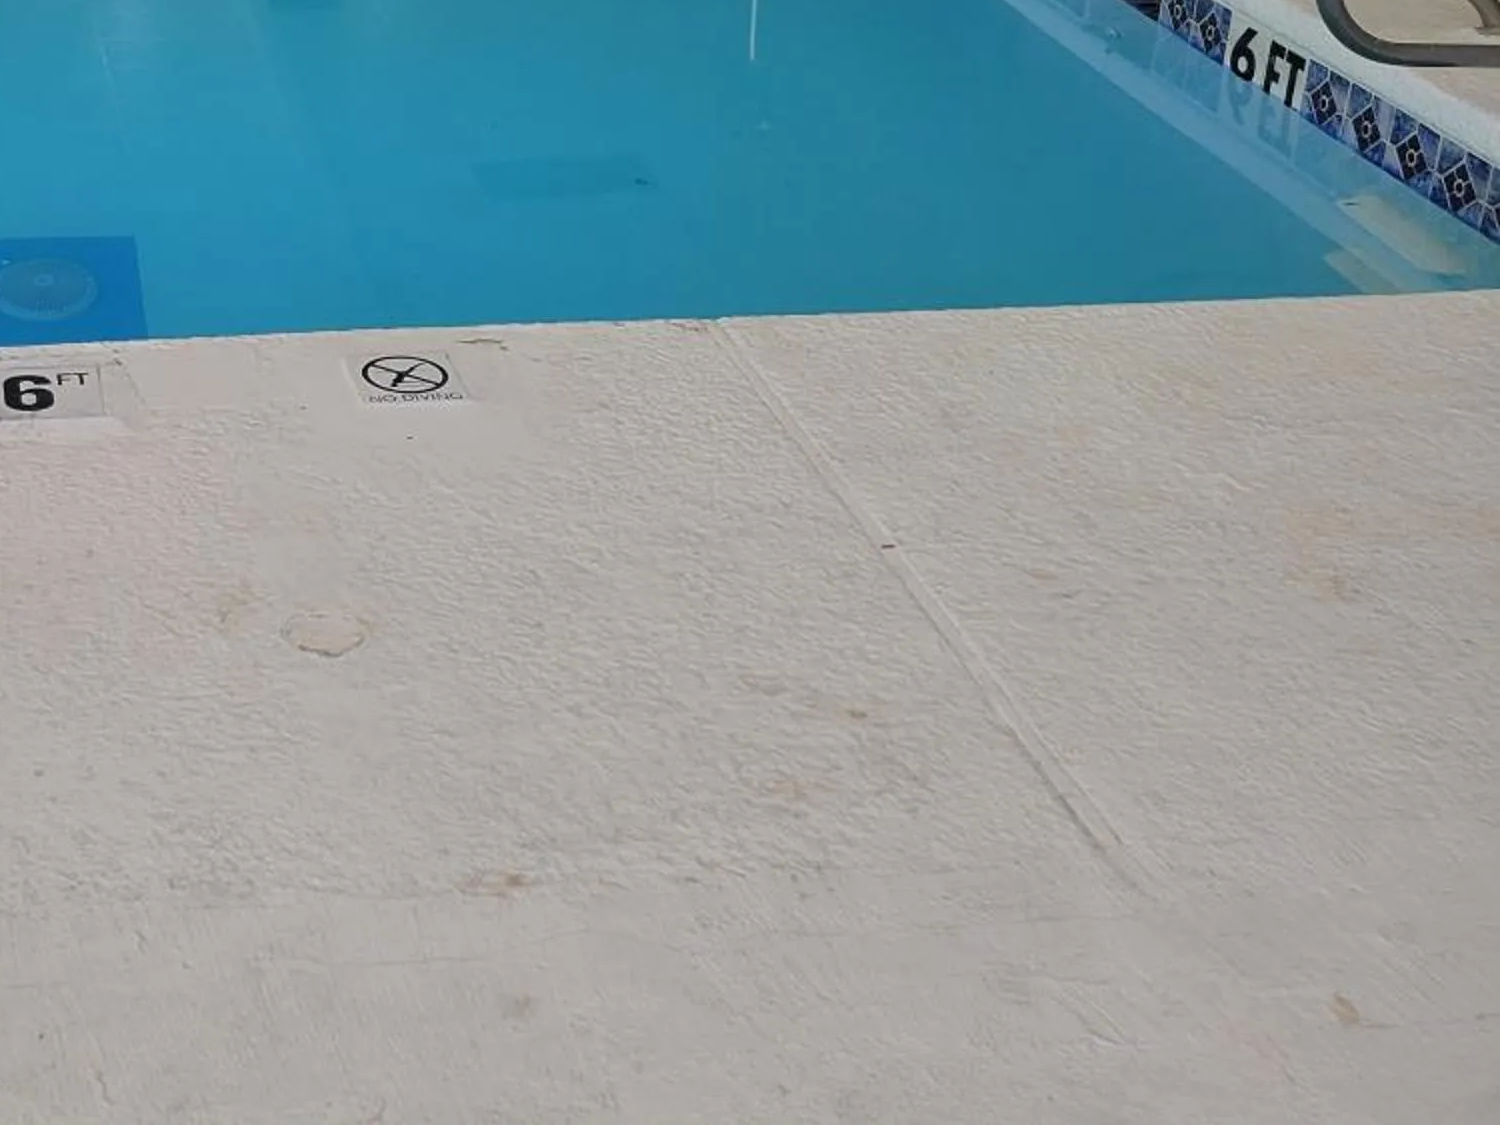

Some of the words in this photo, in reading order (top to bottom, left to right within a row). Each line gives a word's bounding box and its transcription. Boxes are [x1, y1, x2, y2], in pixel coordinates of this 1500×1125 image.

[1230, 26, 1258, 82] 6
[1263, 39, 1307, 108] FT
[3, 374, 55, 412] 6
[56, 372, 89, 386] FT
[368, 394, 398, 403] NO
[401, 392, 463, 402] DIVING
